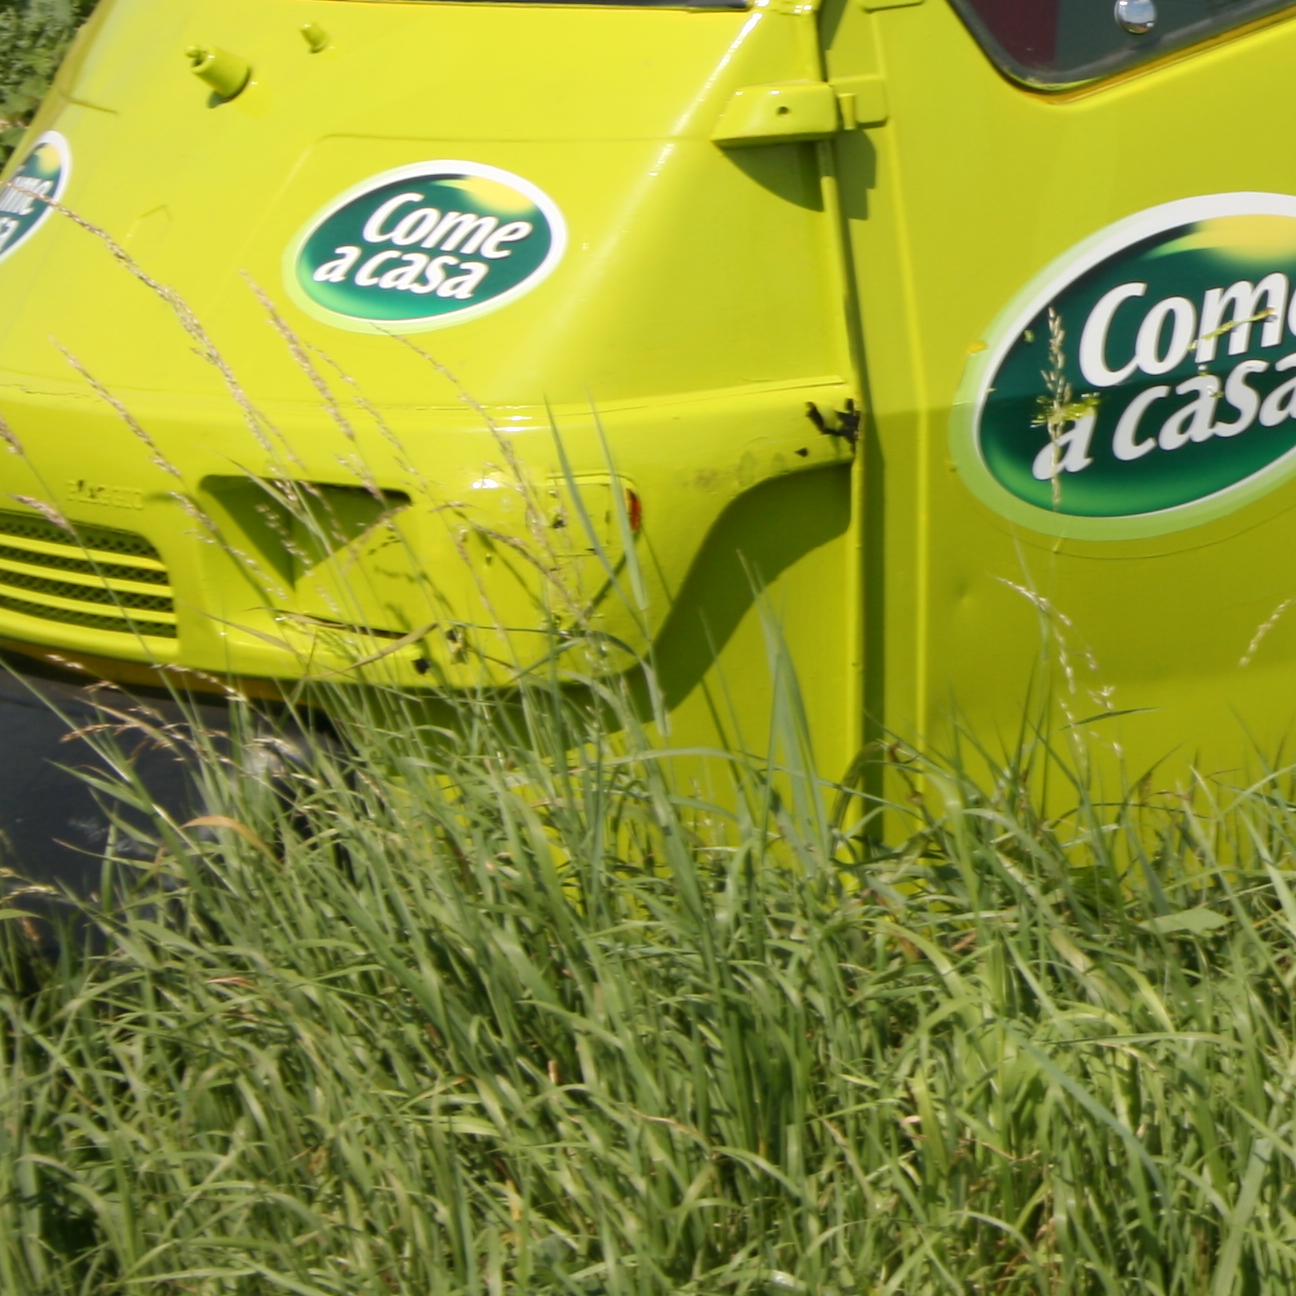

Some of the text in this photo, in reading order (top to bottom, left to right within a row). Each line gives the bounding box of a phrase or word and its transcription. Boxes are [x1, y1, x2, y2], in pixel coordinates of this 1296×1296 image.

[362, 192, 533, 259] Come
[313, 246, 489, 300] a casa
[1032, 400, 1096, 481] a
